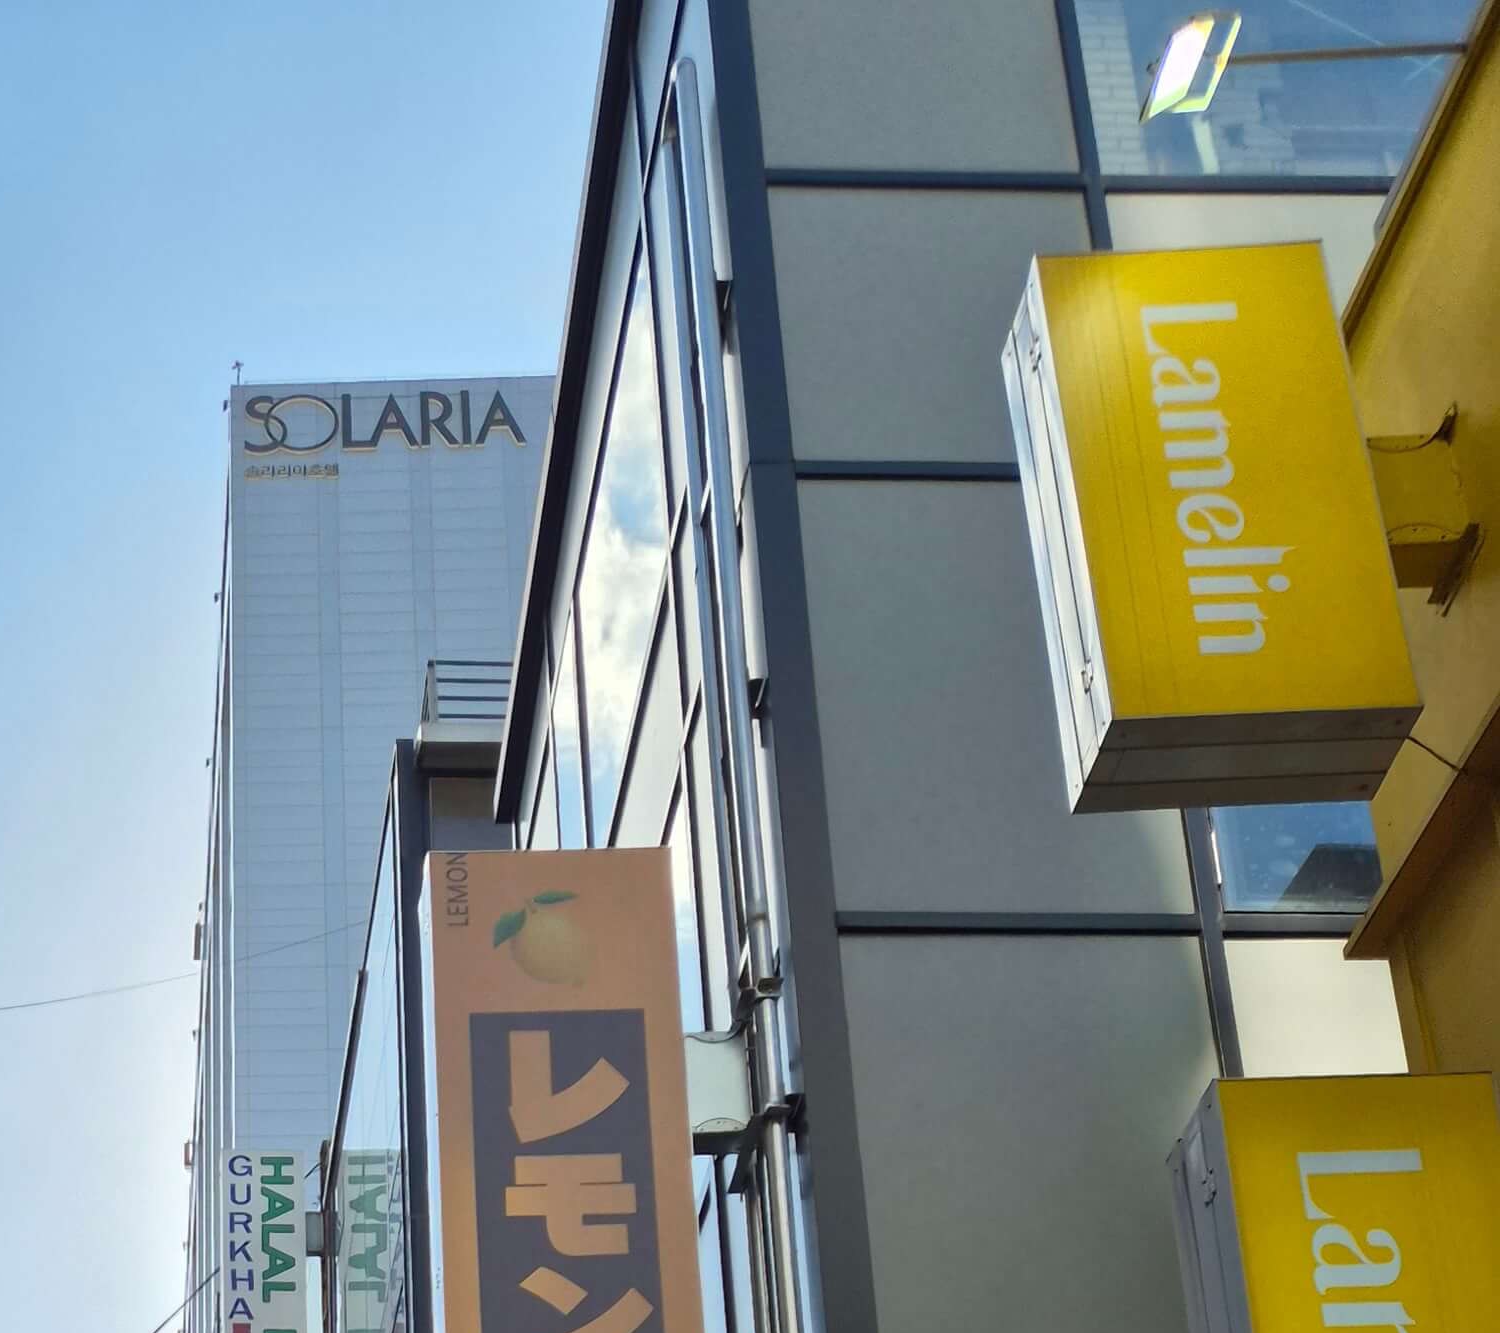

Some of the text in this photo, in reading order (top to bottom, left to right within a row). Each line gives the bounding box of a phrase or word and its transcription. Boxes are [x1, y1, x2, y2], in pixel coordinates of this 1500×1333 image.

[243, 389, 528, 453] SOLARIA
[1140, 301, 1291, 655] Lamelin
[446, 852, 469, 928] LEMON
[227, 1155, 254, 1321] GURKHA
[260, 1156, 296, 1303] HALAL
